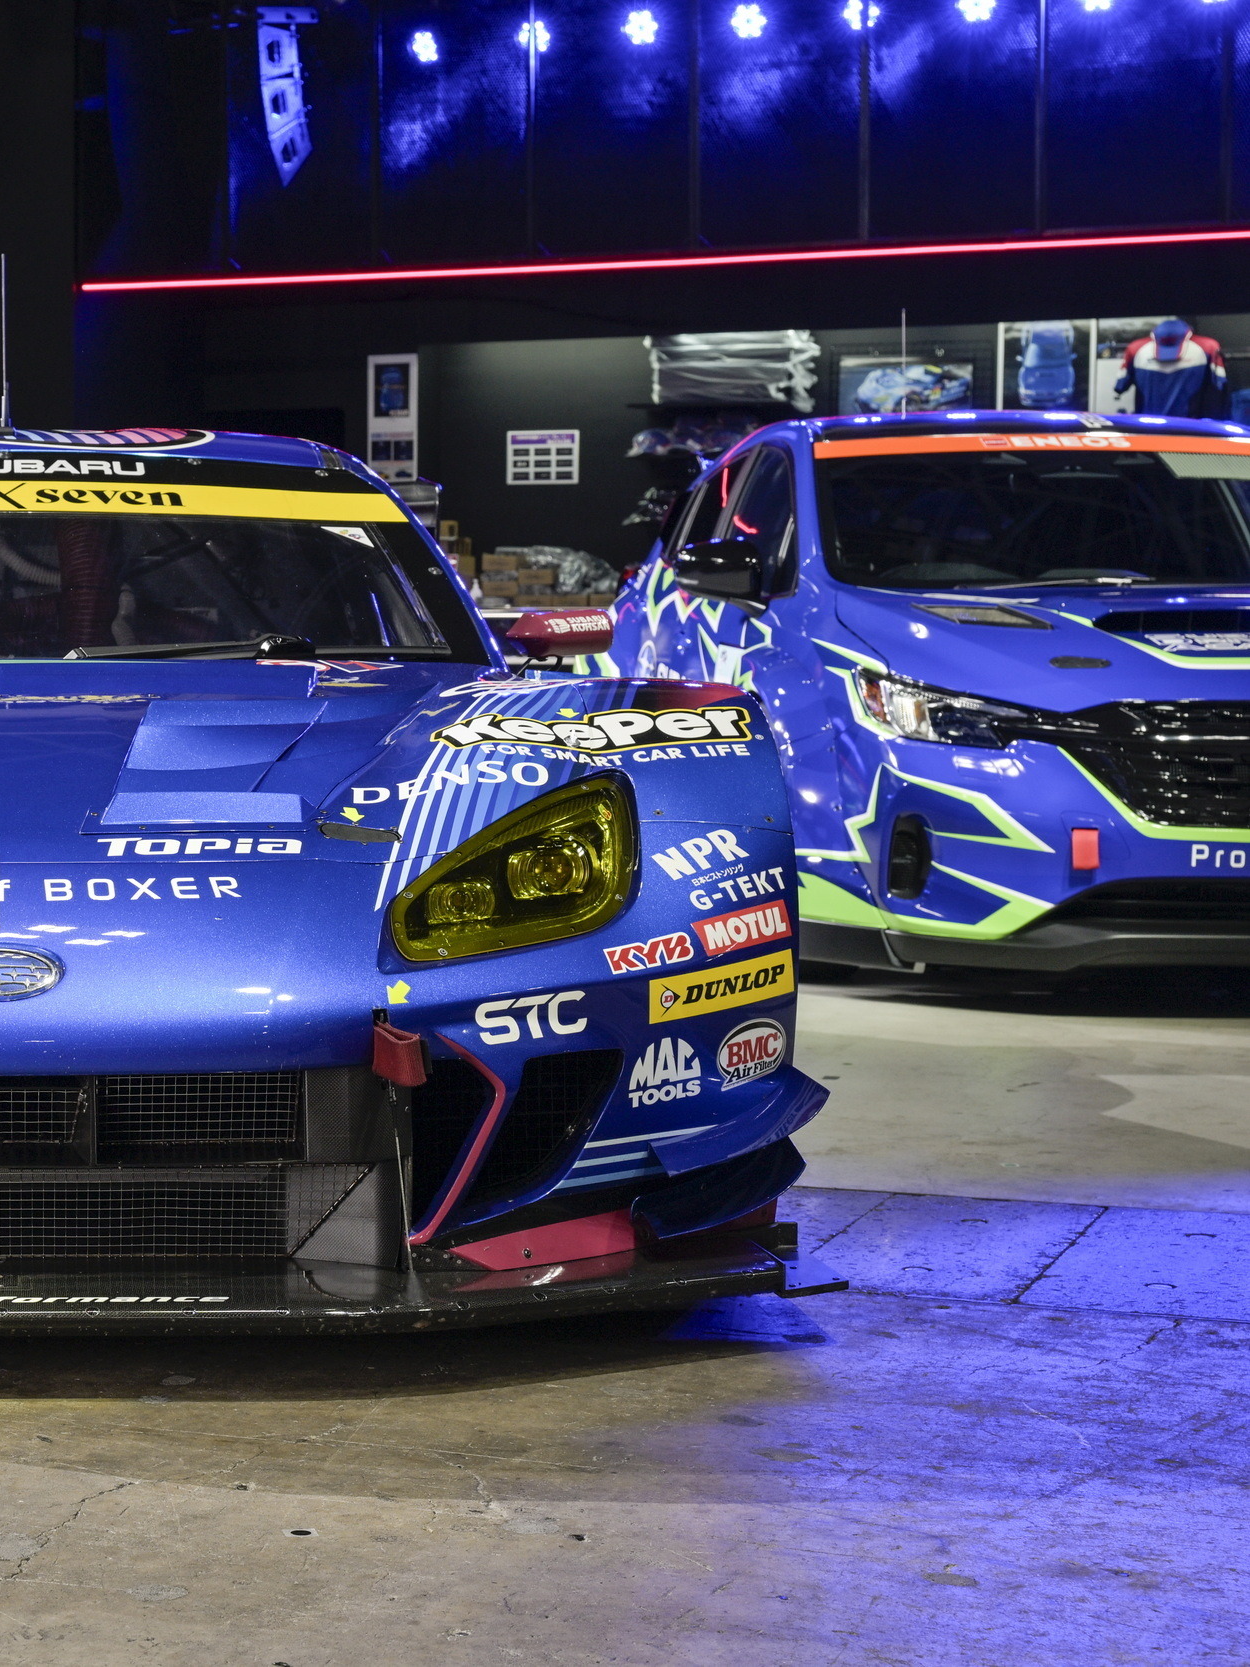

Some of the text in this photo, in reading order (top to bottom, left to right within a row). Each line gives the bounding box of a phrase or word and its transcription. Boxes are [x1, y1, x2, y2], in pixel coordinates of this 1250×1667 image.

[1009, 436, 1131, 448] ENEOS
[35, 487, 185, 507] seven
[566, 614, 608, 624] SUBARU
[570, 621, 610, 633] KOHSAN
[480, 744, 751, 767] FOR SMART CAR LIFE
[351, 760, 549, 804] DENSO
[651, 829, 750, 881] NPR
[1191, 844, 1246, 868] Pro
[44, 876, 242, 901] BOXER
[689, 866, 785, 910] G-TEKT
[703, 906, 787, 951] MOTUL
[604, 932, 694, 974] KYB
[682, 964, 786, 1005] DUNLOP
[474, 990, 588, 1045] STC
[629, 1037, 701, 1091] MAC
[726, 1032, 778, 1068] BMC
[726, 1065, 752, 1084] Air
[753, 1060, 774, 1075] Filter
[629, 1079, 701, 1108] TOOLS
